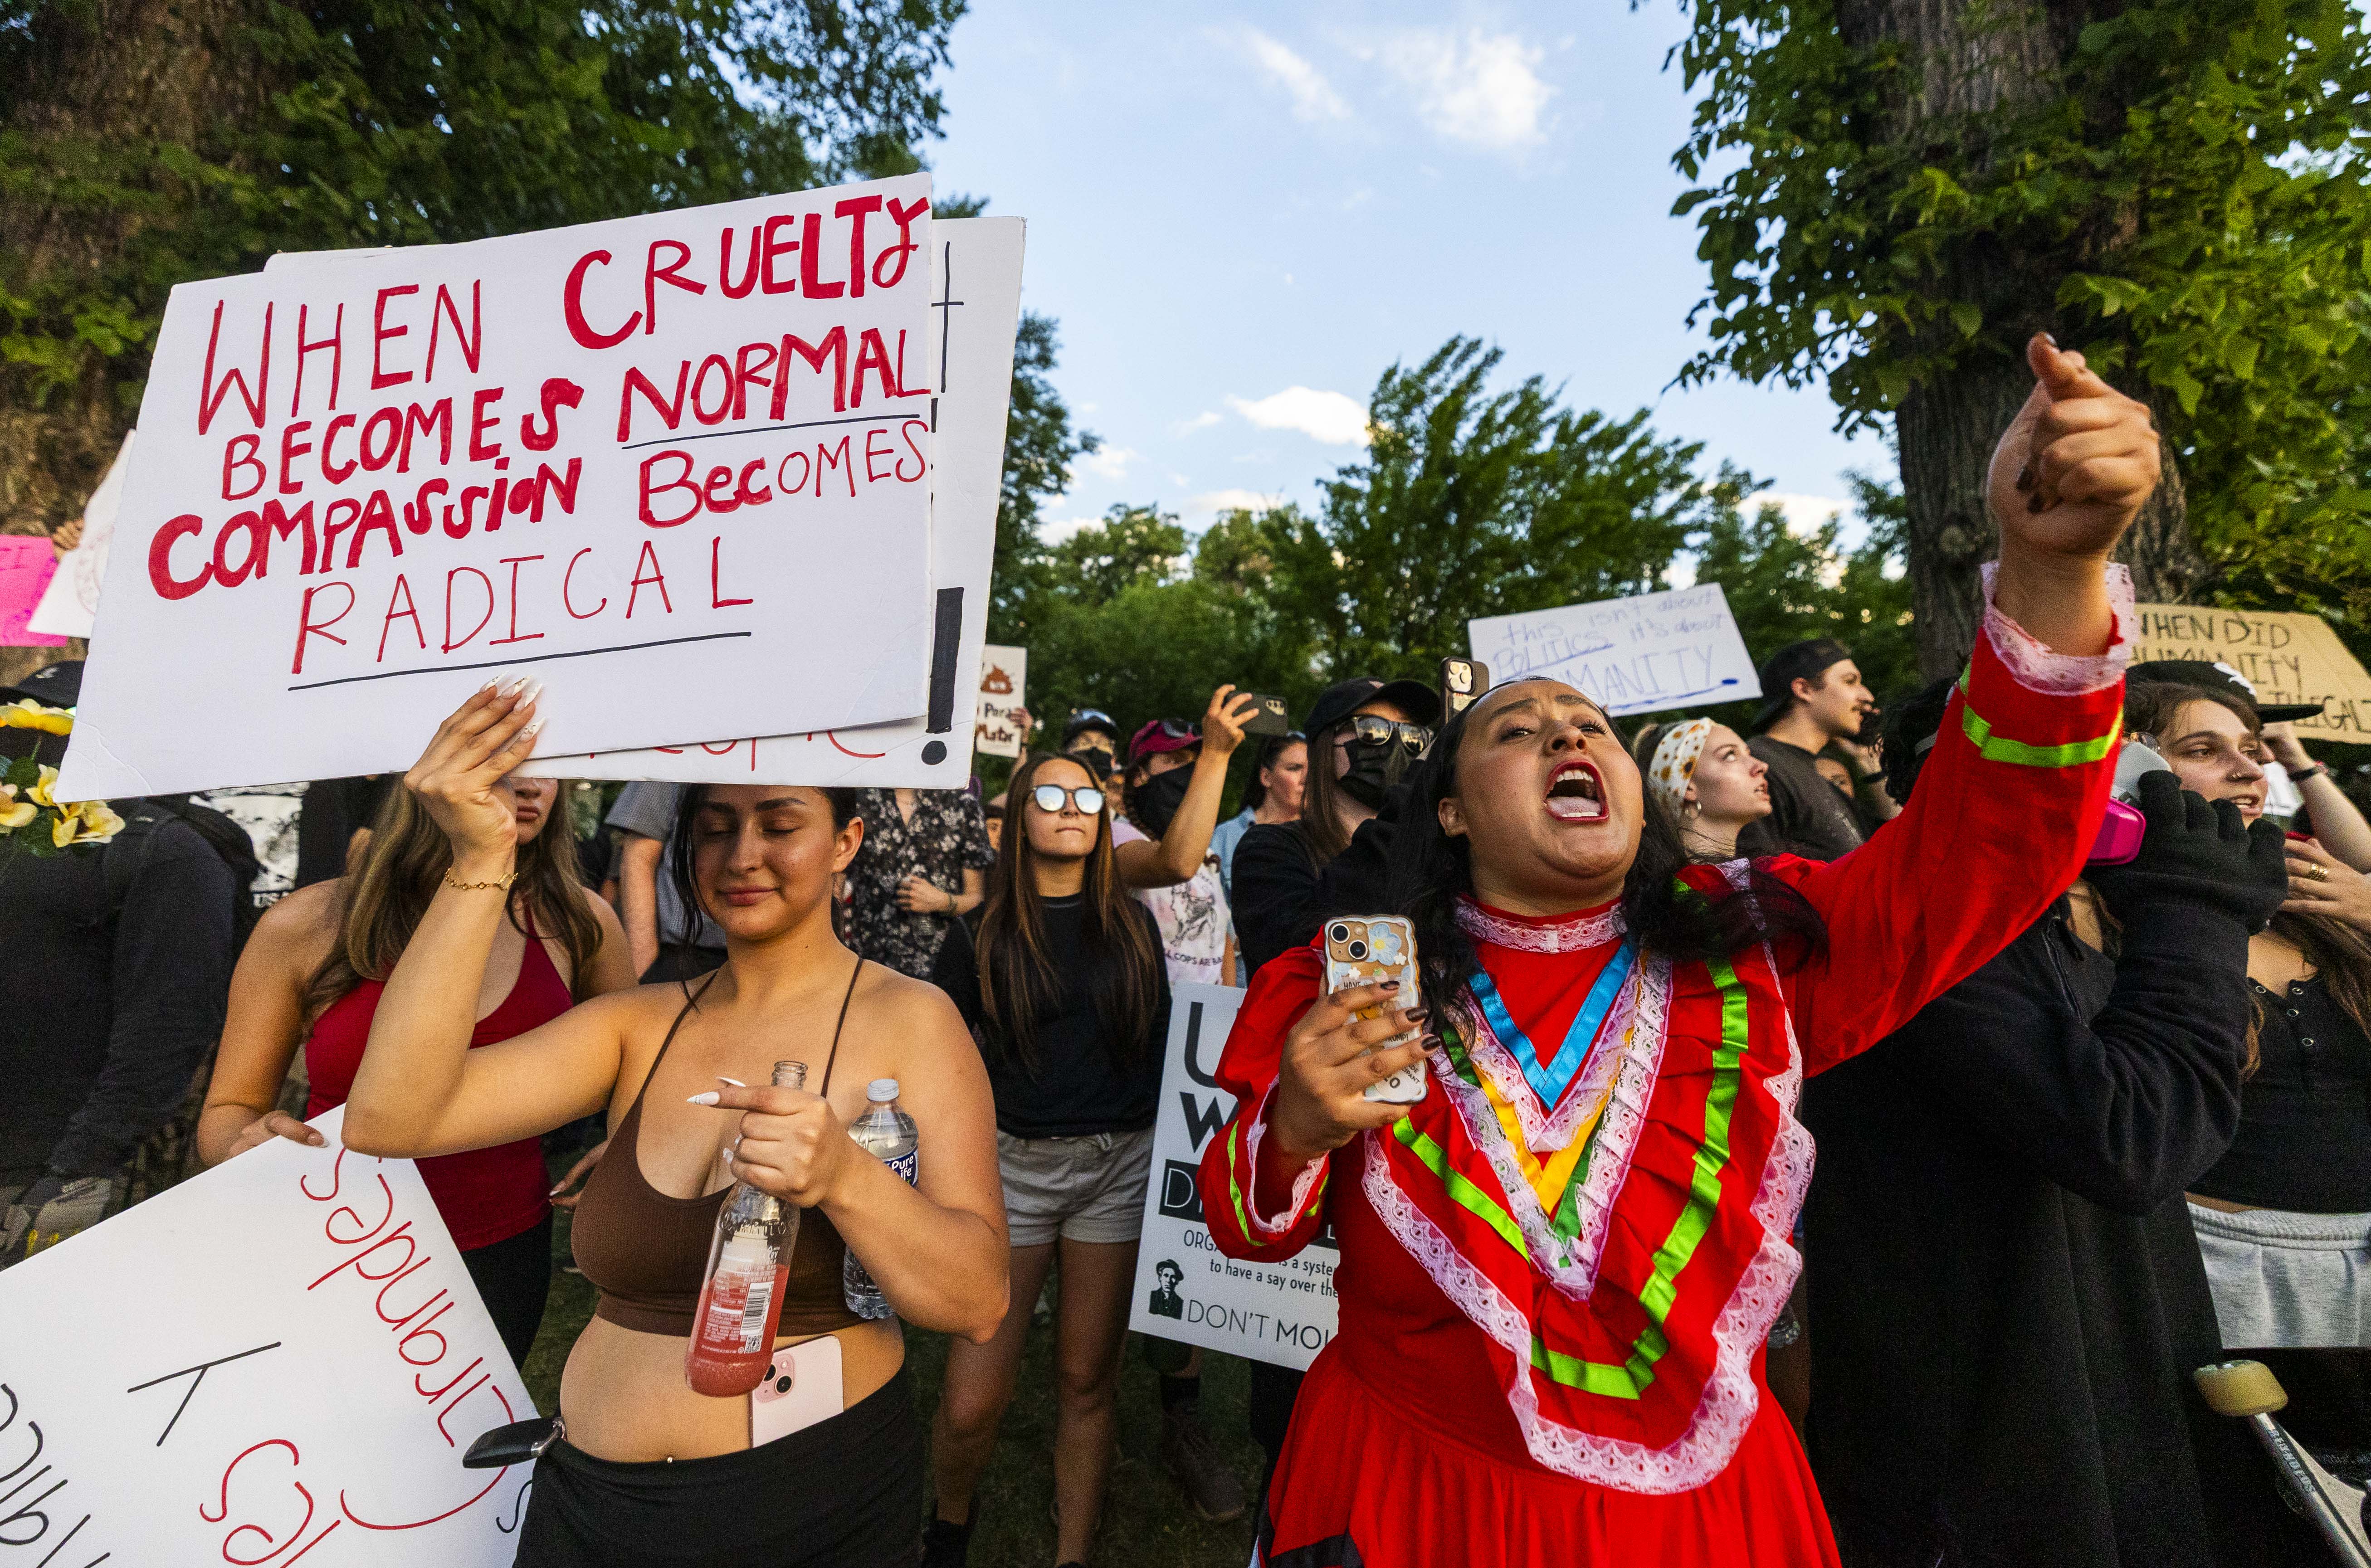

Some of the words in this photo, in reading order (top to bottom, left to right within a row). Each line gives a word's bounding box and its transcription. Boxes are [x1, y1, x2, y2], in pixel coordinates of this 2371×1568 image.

[197, 279, 481, 435] WHEN
[564, 194, 929, 350] CRUELTY
[221, 378, 584, 501] BECOMES
[617, 326, 931, 442] NORMAL
[292, 536, 753, 674] RADICAL
[2224, 617, 2290, 648] DID
[892, 1156, 913, 1170] Pure
[900, 1167, 912, 1181] ife
[1210, 1259, 1221, 1273] to
[1225, 1259, 1252, 1280] have
[1256, 1273, 1263, 1282] a
[1267, 1275, 1286, 1291] say
[1290, 1280, 1316, 1293] over
[1293, 1259, 1298, 1269] a
[1188, 1300, 1269, 1338] DON'T
